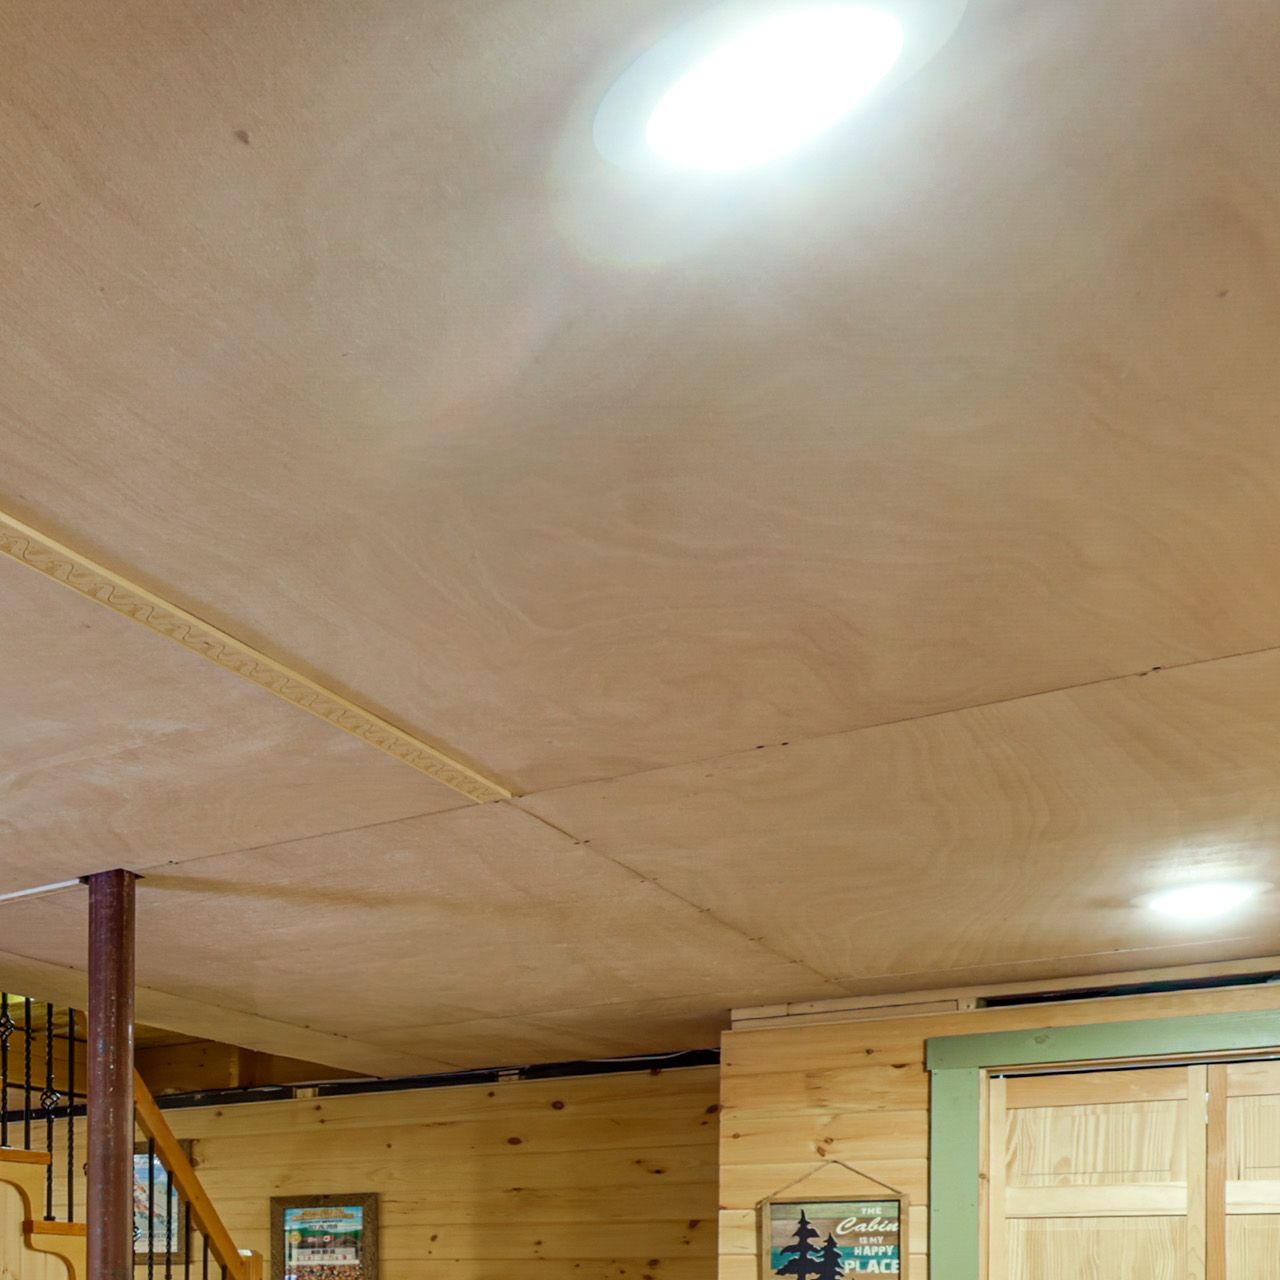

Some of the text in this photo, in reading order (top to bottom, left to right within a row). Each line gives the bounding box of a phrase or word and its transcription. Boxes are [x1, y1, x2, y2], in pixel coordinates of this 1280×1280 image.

[861, 1207, 882, 1215] THE
[835, 1216, 899, 1235] Cabin
[859, 1236, 885, 1244] IS MY
[853, 1245, 894, 1256] HAPPY
[844, 1258, 900, 1274] PLACE
